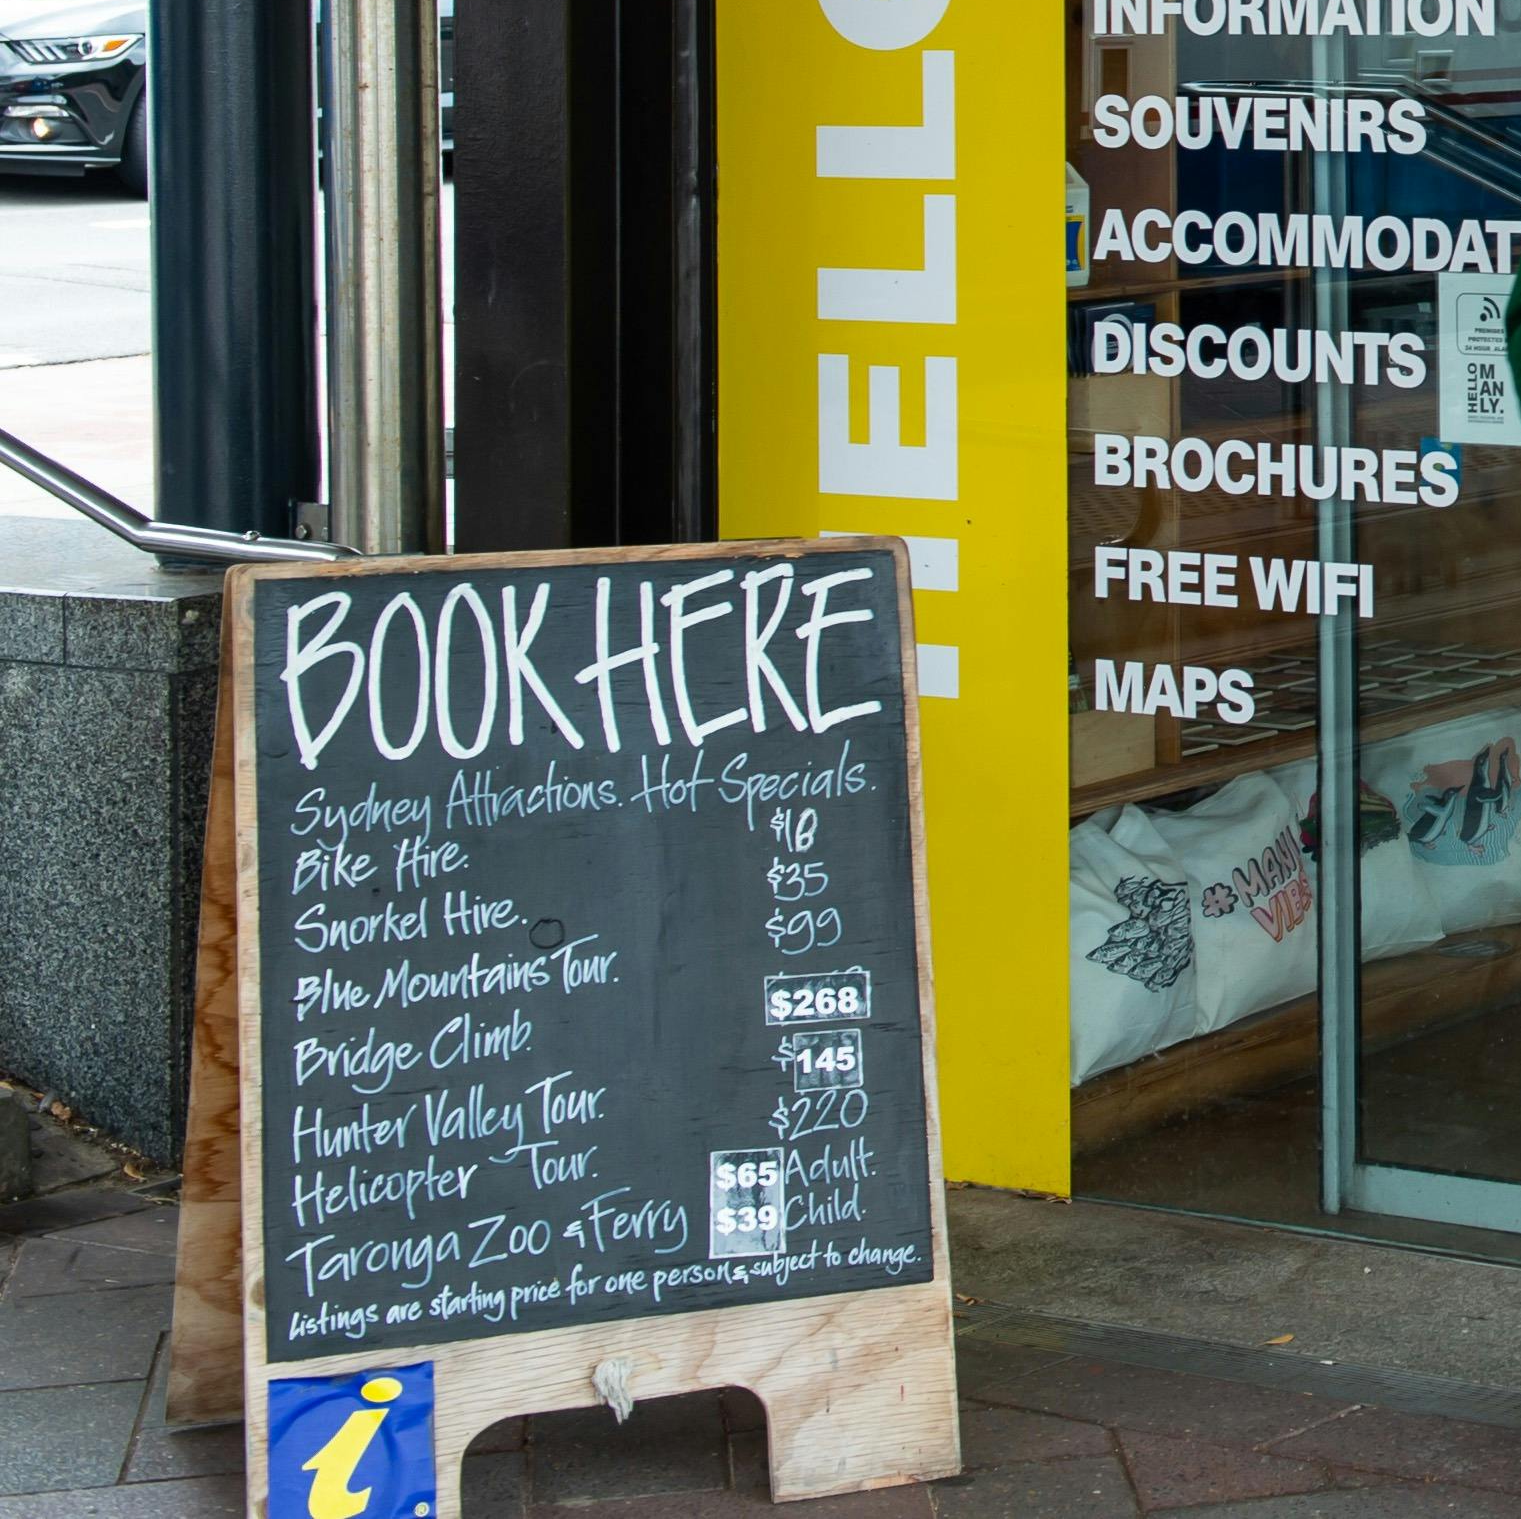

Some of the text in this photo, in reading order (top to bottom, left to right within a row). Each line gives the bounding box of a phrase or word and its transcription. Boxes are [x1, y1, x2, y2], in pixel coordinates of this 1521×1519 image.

[1092, 93, 1427, 155] SOUVENIRS
[1093, 320, 1427, 388] DISCOUNTS
[1467, 362, 1478, 414] HELLO
[1093, 435, 1461, 509] BROCHURES
[1093, 545, 1374, 619] FREE WIFI
[280, 562, 882, 770] BOOK HERE
[1093, 659, 1256, 725] MAPS
[291, 781, 432, 850] Sydney
[632, 748, 716, 813] Hot
[290, 841, 378, 896] Bike
[766, 857, 829, 901] $35
[293, 900, 428, 953] Snorkel
[765, 906, 843, 955] $99
[290, 968, 371, 1022] Blue
[373, 951, 550, 1010] Mountains
[769, 988, 859, 1017] $268
[294, 1024, 422, 1096] Bridge
[292, 1101, 417, 1165] Hunter
[424, 1089, 524, 1165] Valley
[767, 1088, 869, 1142] $220
[291, 1160, 478, 1229] Helicopter
[715, 1160, 779, 1190] $65
[285, 1229, 460, 1297] Taronga
[467, 1217, 552, 1272] Zoo
[581, 1187, 689, 1259] Ferry
[715, 1203, 779, 1234] $39
[289, 1296, 379, 1342] Listings
[385, 1296, 422, 1325] are
[428, 1278, 506, 1323] starting
[509, 1275, 562, 1319] price
[565, 1269, 600, 1311] for
[603, 1270, 648, 1295] one
[821, 1245, 844, 1270] to
